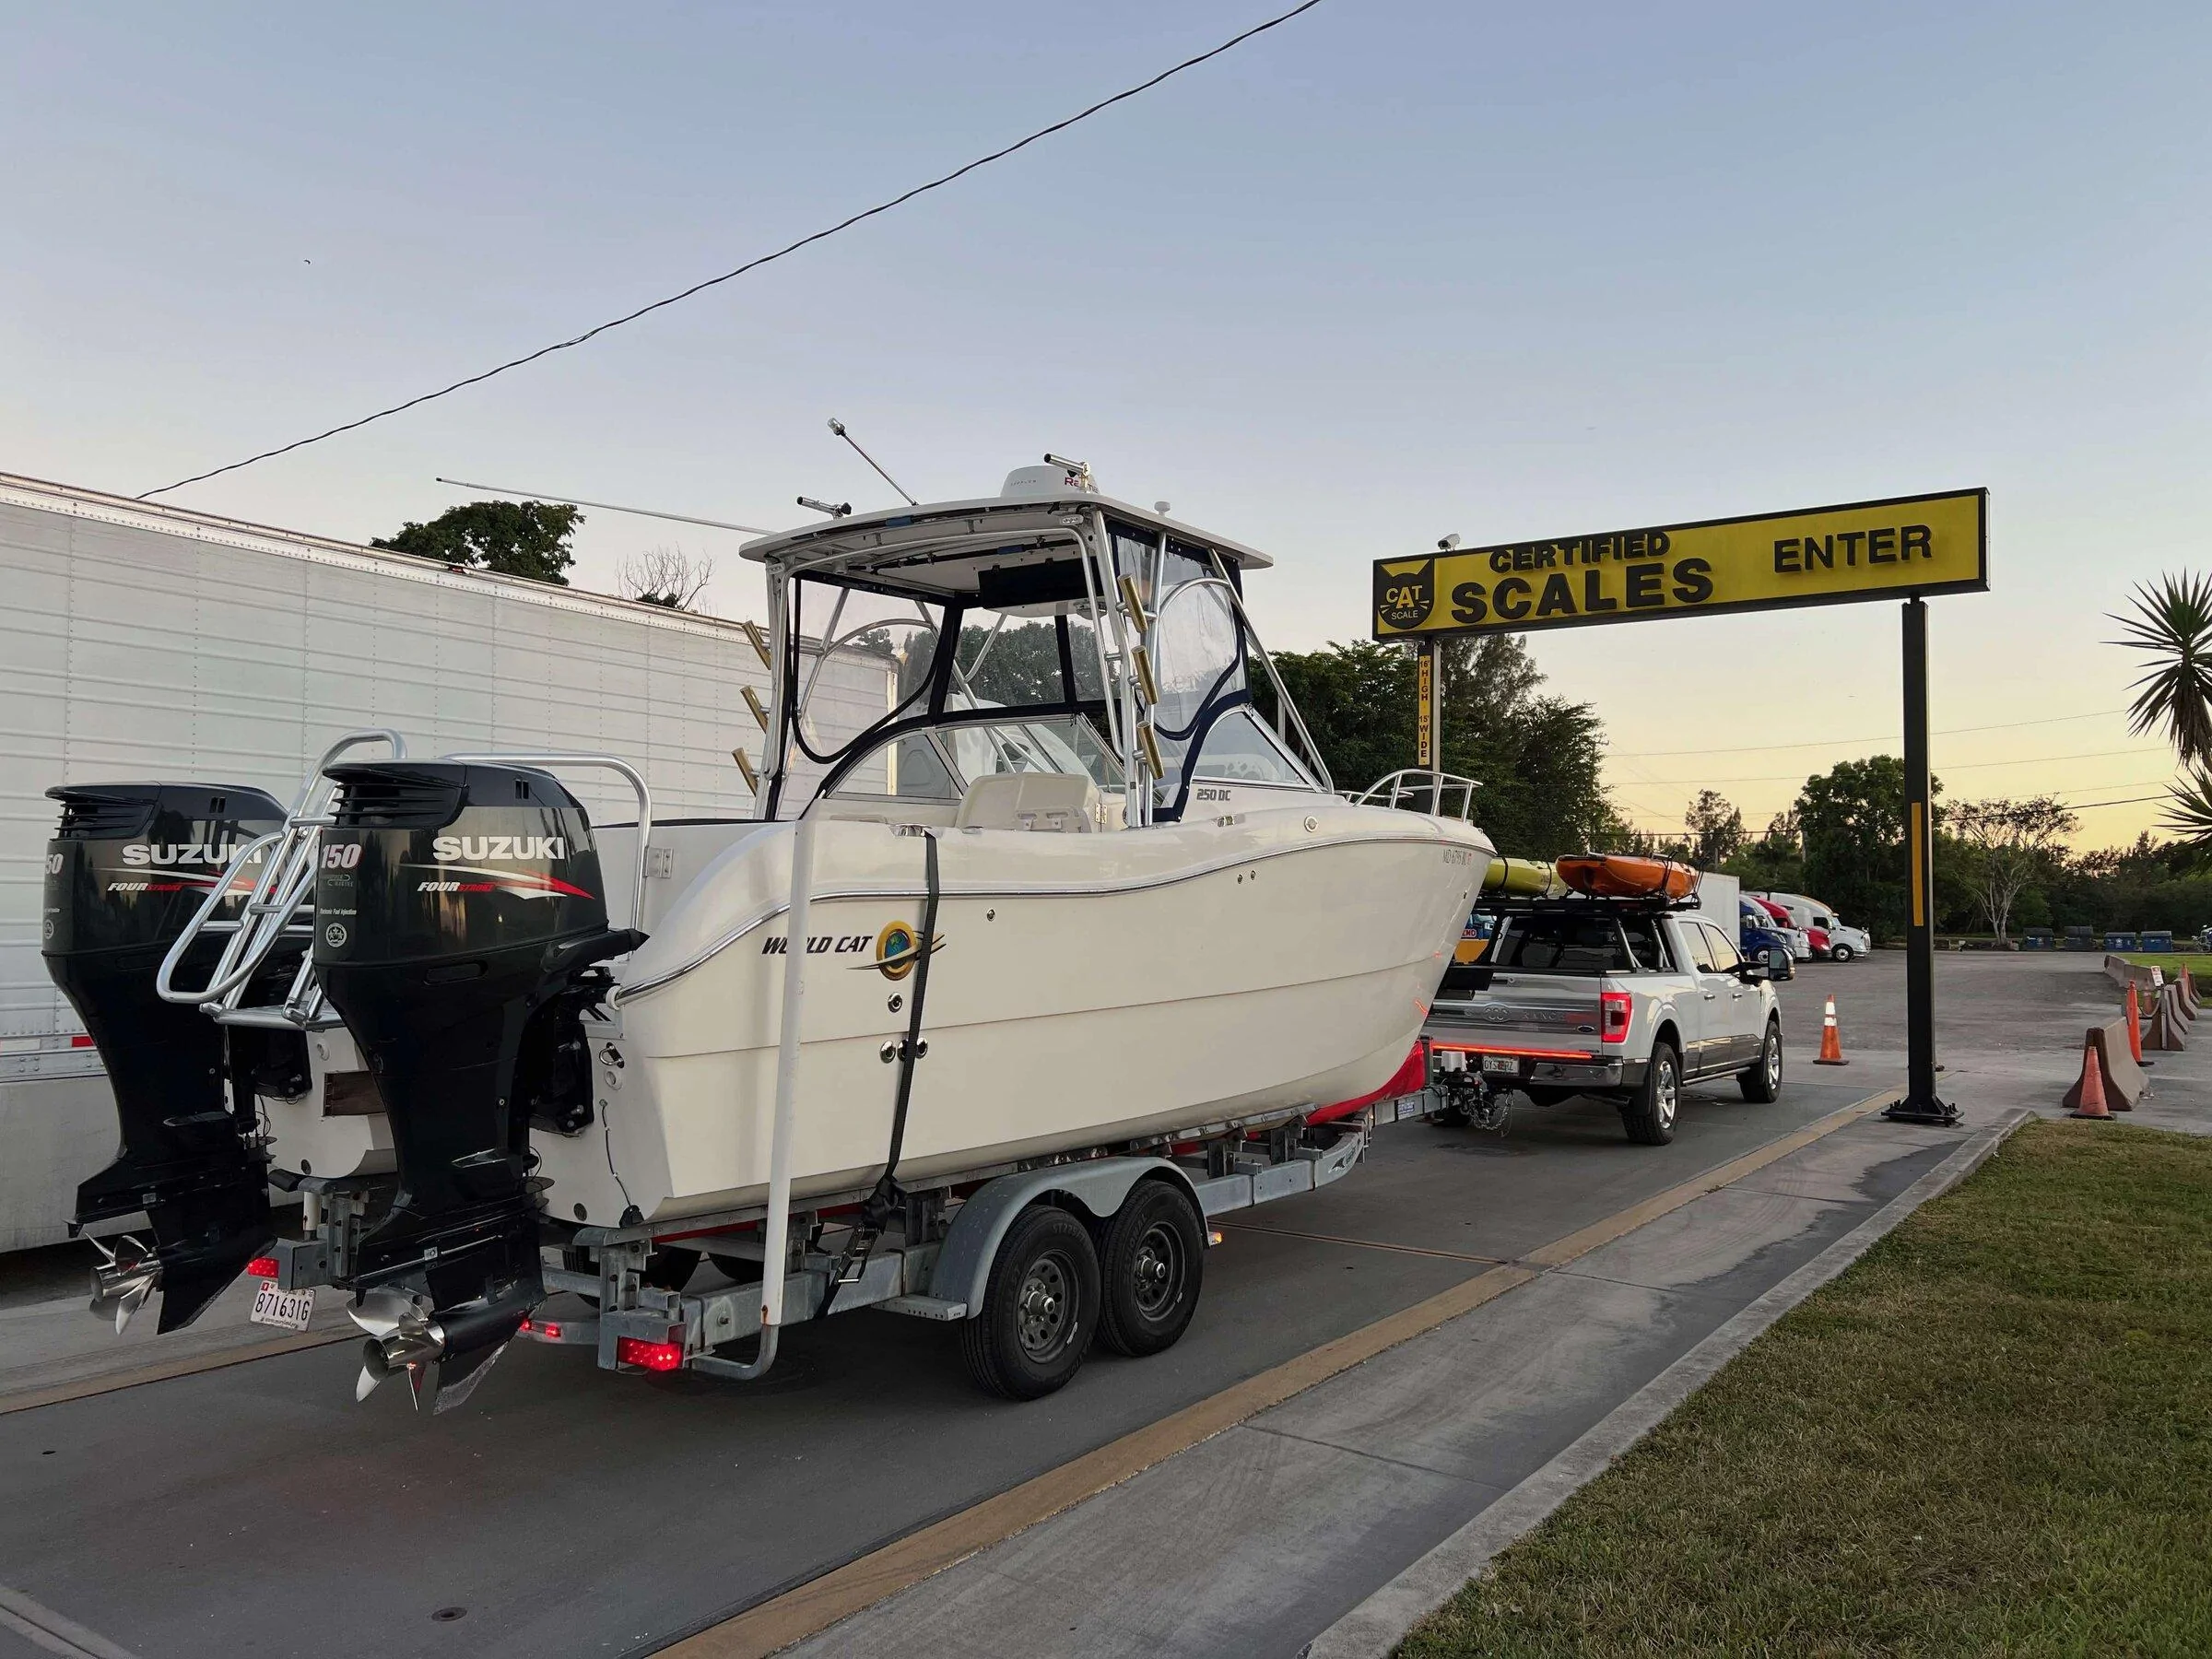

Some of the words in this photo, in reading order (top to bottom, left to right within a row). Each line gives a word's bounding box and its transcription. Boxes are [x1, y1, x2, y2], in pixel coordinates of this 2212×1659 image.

[1489, 531, 1671, 573] CERTIFIED
[1774, 524, 1932, 573] ENTER
[1386, 584, 1423, 609] CAT
[1451, 558, 1714, 624] SCALES
[1391, 609, 1418, 620] SCALE
[1418, 724, 1429, 758] WIDE
[1196, 788, 1216, 801] 250
[1218, 789, 1231, 801] DC
[321, 843, 362, 869] 150
[432, 836, 565, 861] SUZUKI
[45, 853, 64, 875] 50
[761, 936, 833, 955] WLD
[834, 935, 874, 954] CAT
[255, 1292, 310, 1321] 871631G
